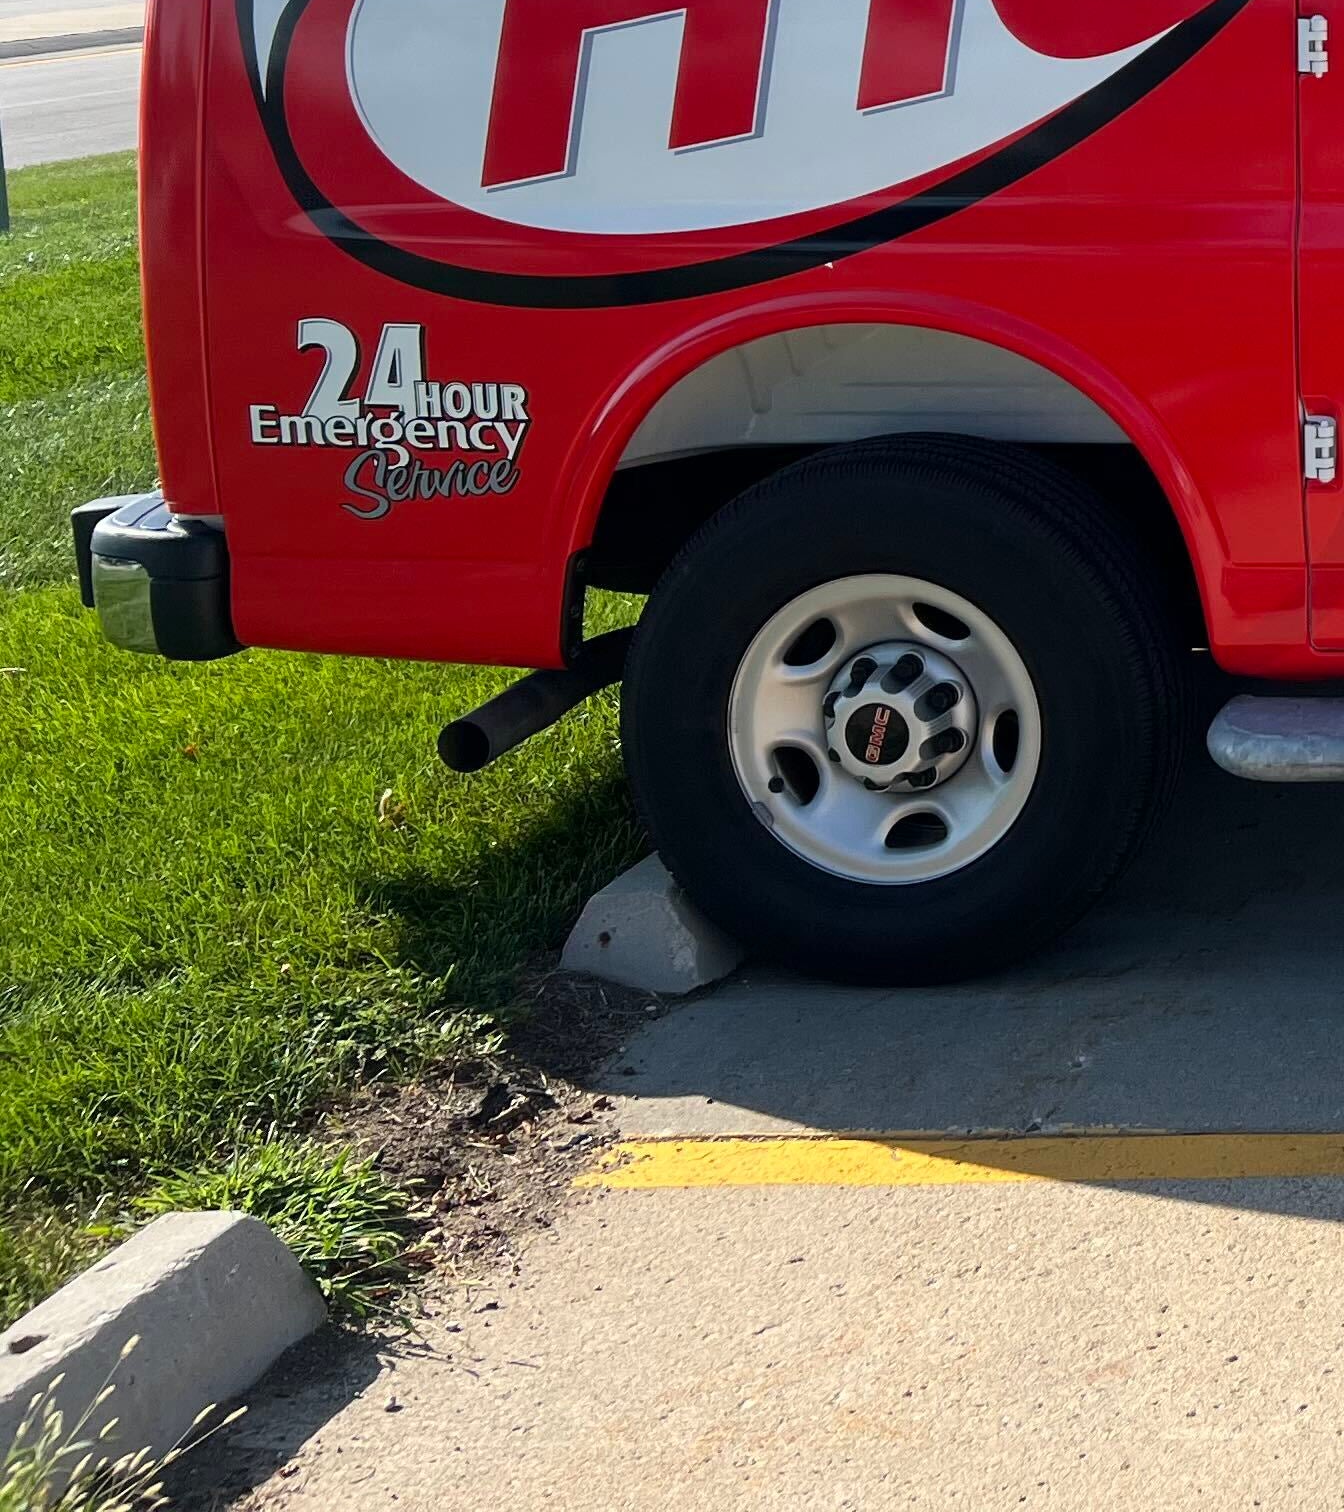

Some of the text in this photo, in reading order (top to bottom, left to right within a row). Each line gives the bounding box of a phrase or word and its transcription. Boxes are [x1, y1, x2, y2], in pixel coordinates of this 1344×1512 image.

[297, 317, 530, 424] 24 HOUR
[249, 403, 527, 471] Emergency
[341, 449, 520, 519] Service
[865, 706, 892, 764] GMC
